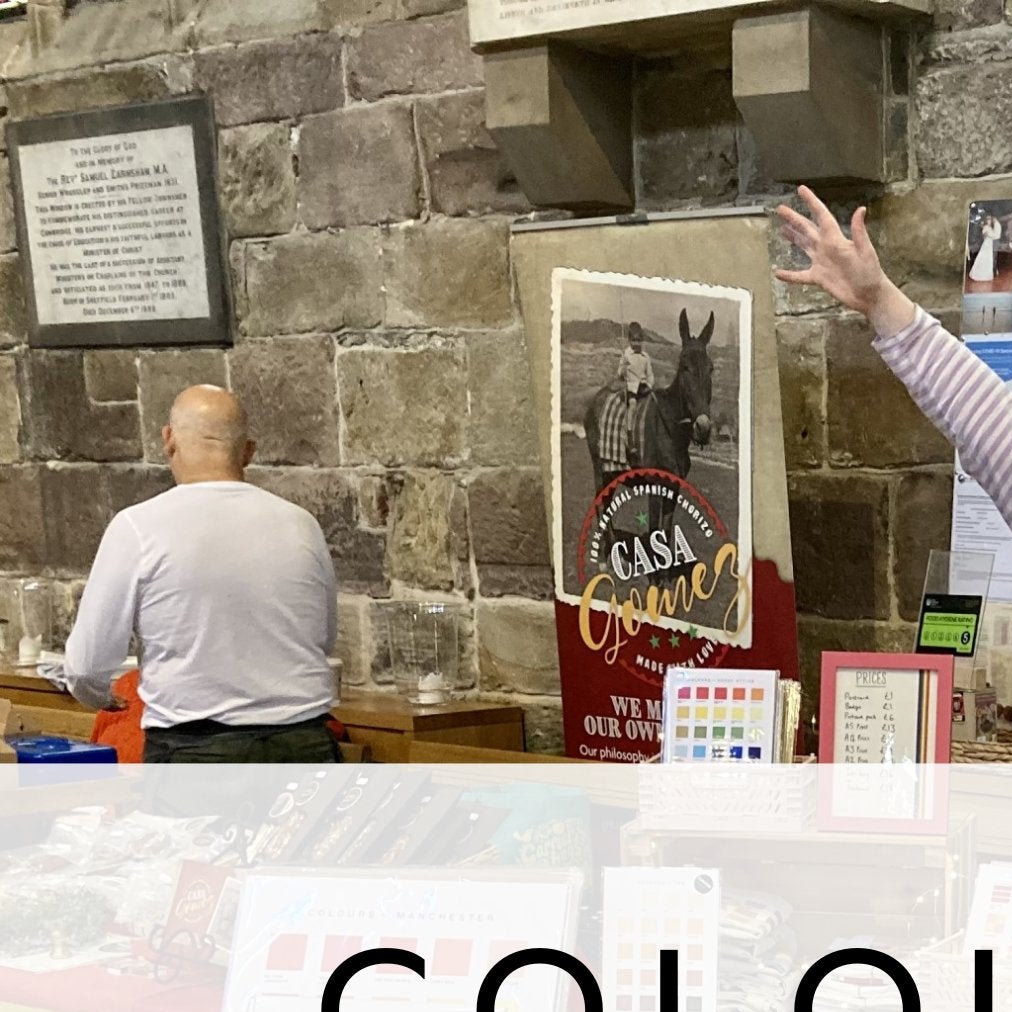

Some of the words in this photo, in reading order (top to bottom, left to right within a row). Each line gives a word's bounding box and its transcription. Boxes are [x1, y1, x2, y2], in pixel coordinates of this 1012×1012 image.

[599, 490, 632, 530] NATURAL
[633, 484, 674, 500] SPANISH
[677, 494, 714, 538] CHORIZO
[611, 525, 697, 581] CASA
[579, 543, 750, 665] Gomez
[963, 632, 969, 643] 5
[636, 654, 664, 674] MADE
[856, 671, 886, 685] PRICES
[610, 695, 642, 718] WE
[583, 715, 622, 738] OUR
[579, 744, 597, 756] Our
